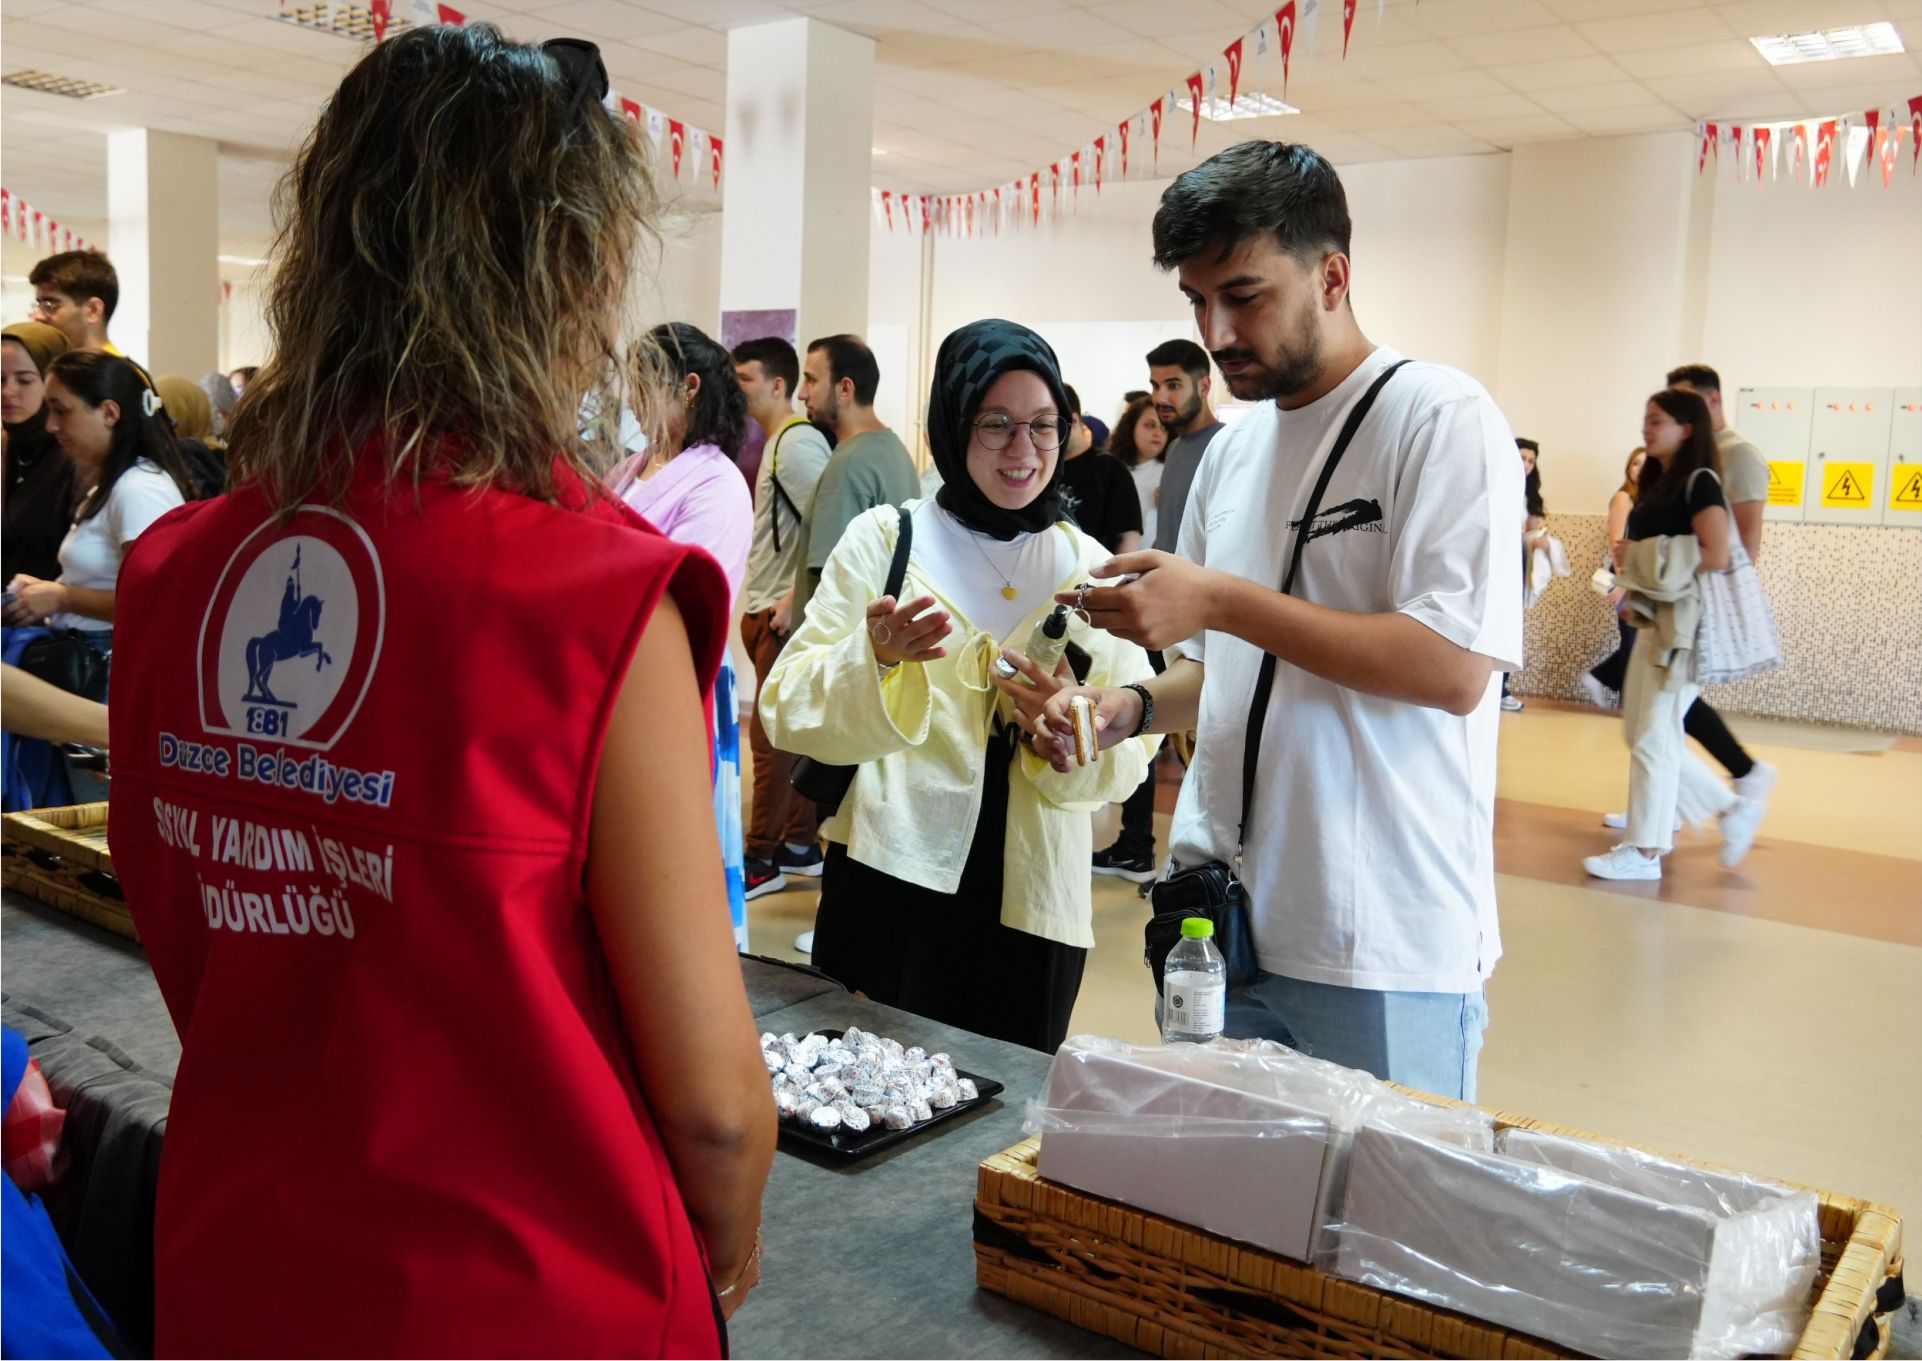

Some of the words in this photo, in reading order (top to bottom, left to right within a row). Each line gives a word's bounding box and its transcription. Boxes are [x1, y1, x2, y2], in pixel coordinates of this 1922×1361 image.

[238, 743, 395, 807] Belediyesi
[153, 796, 200, 857] SSYAL
[211, 814, 315, 873] YARDIM
[312, 824, 393, 903] İŞLERİ
[197, 872, 356, 939] DÜRLÜĞÜ
